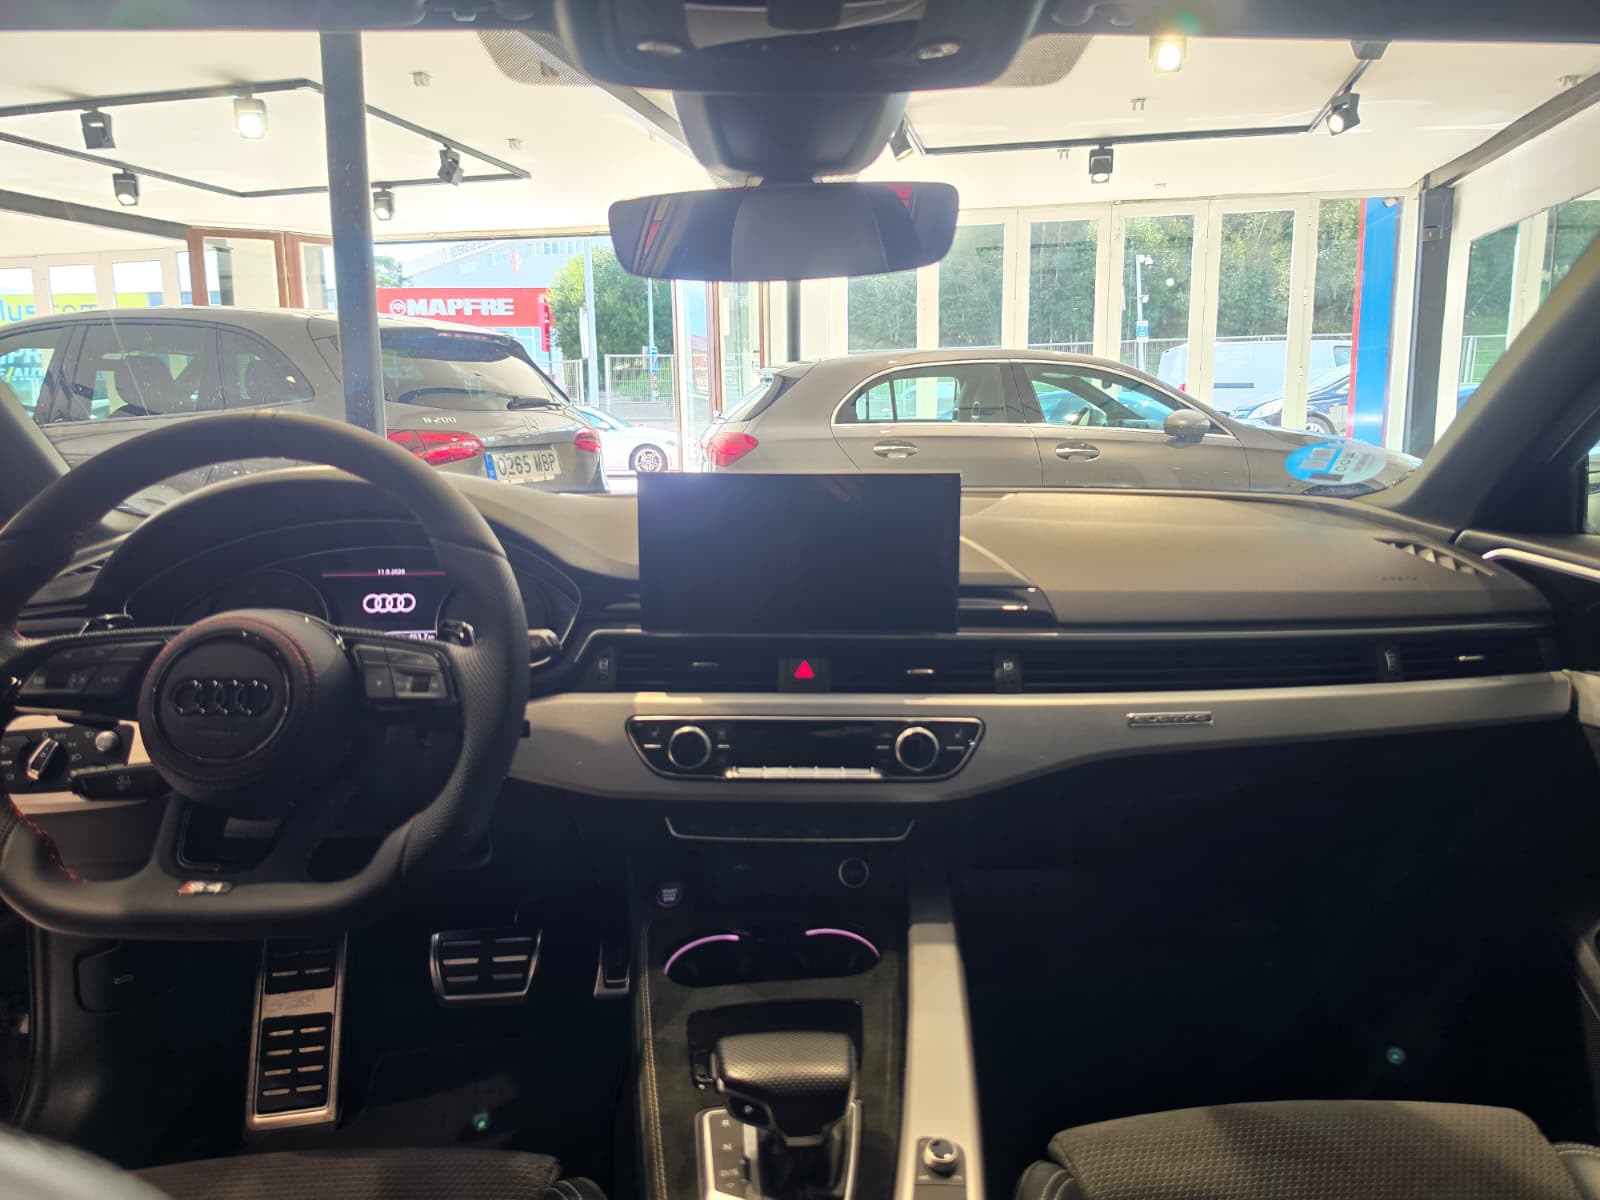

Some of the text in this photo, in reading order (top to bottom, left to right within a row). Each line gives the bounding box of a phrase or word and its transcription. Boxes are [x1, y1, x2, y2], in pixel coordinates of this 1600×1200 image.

[408, 298, 514, 316] MAPFRE
[497, 454, 556, 476] 0265 MBP
